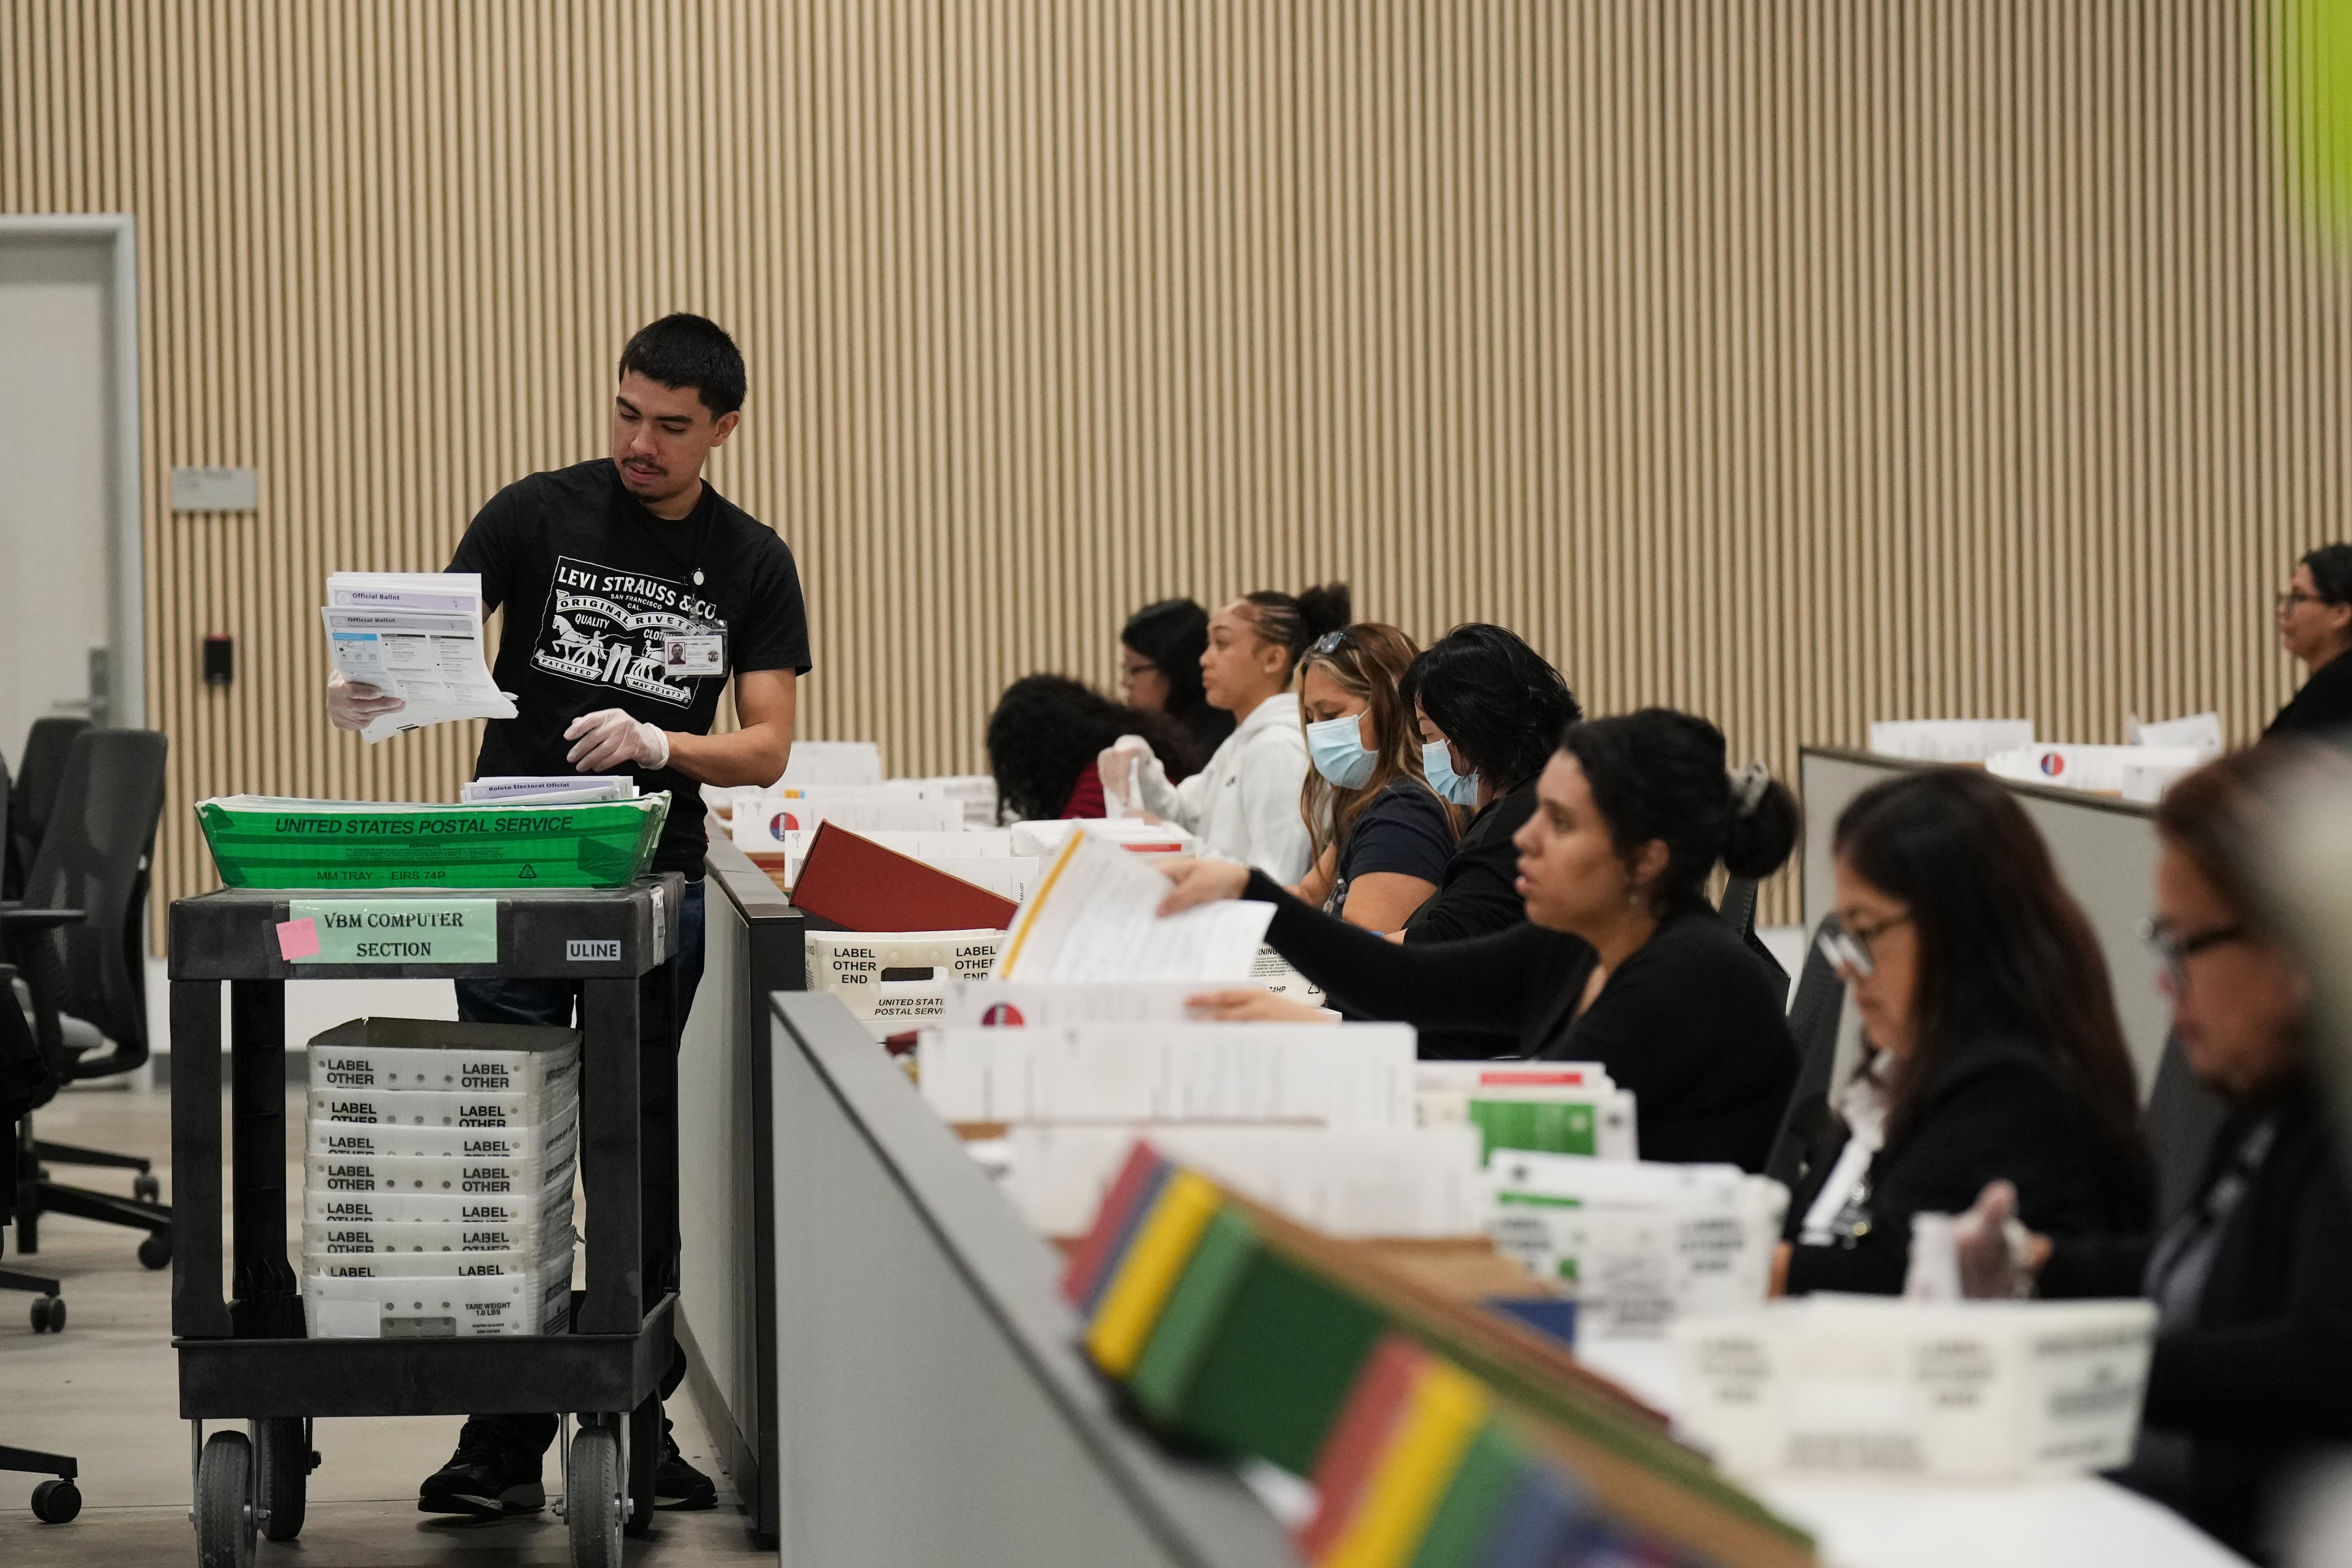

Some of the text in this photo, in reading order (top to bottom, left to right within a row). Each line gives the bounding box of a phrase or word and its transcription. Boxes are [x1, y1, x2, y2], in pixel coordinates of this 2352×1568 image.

[558, 566, 597, 590] LEVI
[602, 577, 676, 606] STRAUSS
[626, 595, 662, 610] FRANCISCO
[561, 599, 628, 624] ORIGINAL
[575, 613, 610, 629] QUALITY
[542, 659, 591, 676] PATENTED
[632, 681, 648, 690] MAY
[661, 689, 681, 698] 1873
[275, 816, 573, 834] UNITED STATES POSTAL SERVICE
[317, 871, 338, 880] MM
[341, 871, 373, 880] TRAY
[391, 871, 420, 880] EIRS
[424, 871, 445, 880] 74P
[324, 912, 363, 928] VBM
[367, 912, 464, 928] COMPUTER
[356, 942, 431, 957] SECTION
[570, 944, 617, 957] ULINE
[834, 948, 875, 958] LABEL
[956, 946, 996, 956] LABEL
[833, 961, 876, 971] OTHER
[842, 974, 867, 984] END
[964, 972, 988, 982] END
[328, 1059, 373, 1071] LABEL
[463, 1064, 509, 1075] LABEL
[327, 1073, 374, 1084] OTHER
[461, 1077, 509, 1088] OTHER
[332, 1102, 376, 1114] LABEL
[460, 1106, 505, 1116] LABEL
[329, 1136, 374, 1148] LABEL
[464, 1141, 509, 1151] LABEL
[328, 1165, 374, 1177] LABEL
[463, 1168, 509, 1178] LABEL
[327, 1178, 374, 1190] OTHER
[462, 1181, 510, 1192] OTHER
[327, 1203, 373, 1214] LABEL
[462, 1207, 508, 1217] LABEL
[328, 1232, 373, 1242] LABEL
[463, 1232, 509, 1243] LABEL
[331, 1267, 375, 1277] LABEL
[459, 1265, 504, 1276] LABEL
